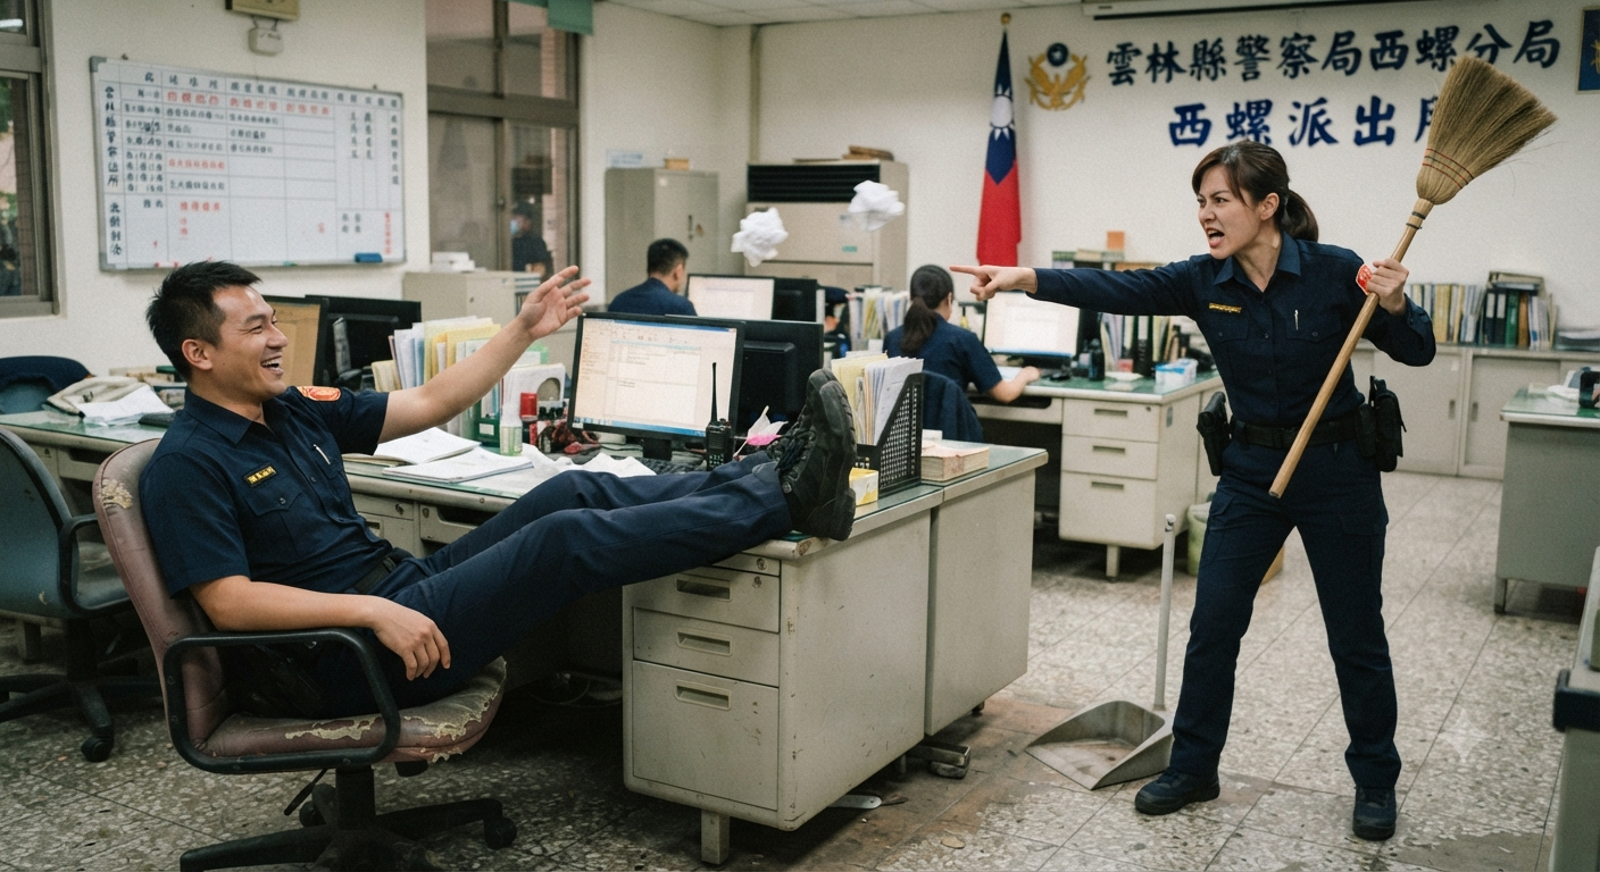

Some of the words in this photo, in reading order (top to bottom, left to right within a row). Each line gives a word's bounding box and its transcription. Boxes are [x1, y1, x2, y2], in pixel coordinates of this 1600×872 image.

[1106, 19, 1561, 87] 雲林縣警察局西螺分局
